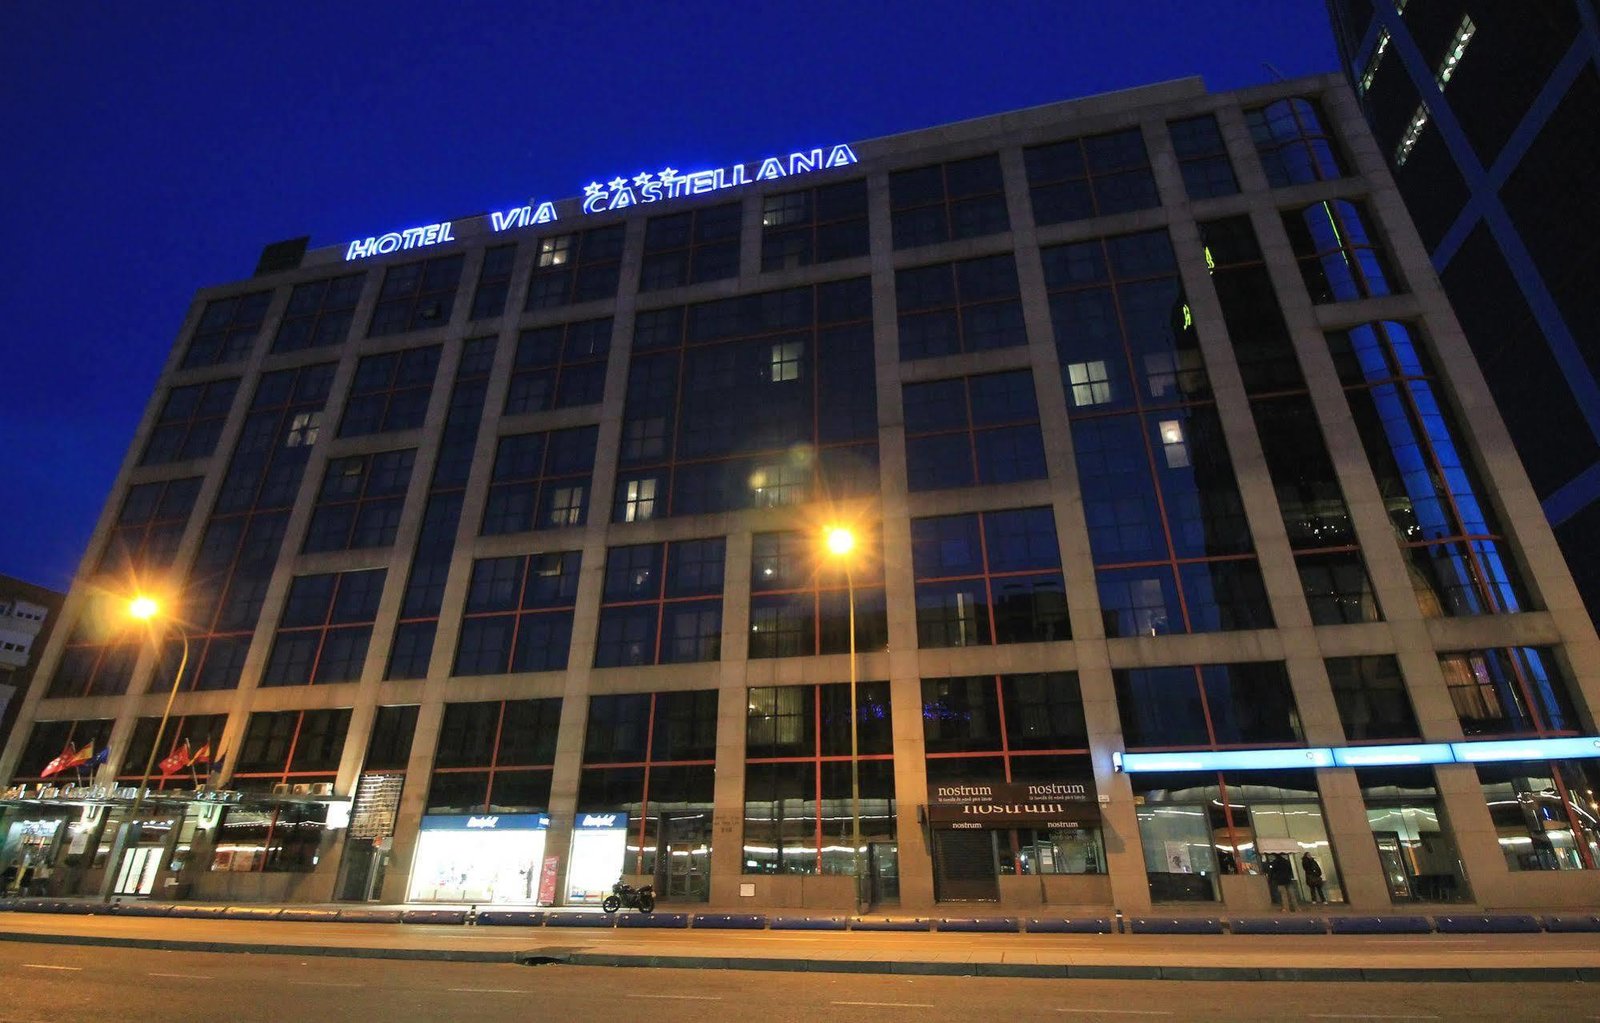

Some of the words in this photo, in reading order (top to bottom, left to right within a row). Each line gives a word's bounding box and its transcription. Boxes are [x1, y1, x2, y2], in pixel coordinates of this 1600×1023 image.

[345, 221, 455, 262] HOTEL
[490, 201, 558, 233] VIA
[582, 143, 858, 214] CASTELLANA
[938, 785, 992, 796] nostrum
[1029, 783, 1085, 794] nostrum
[1047, 821, 1079, 829] nostrum
